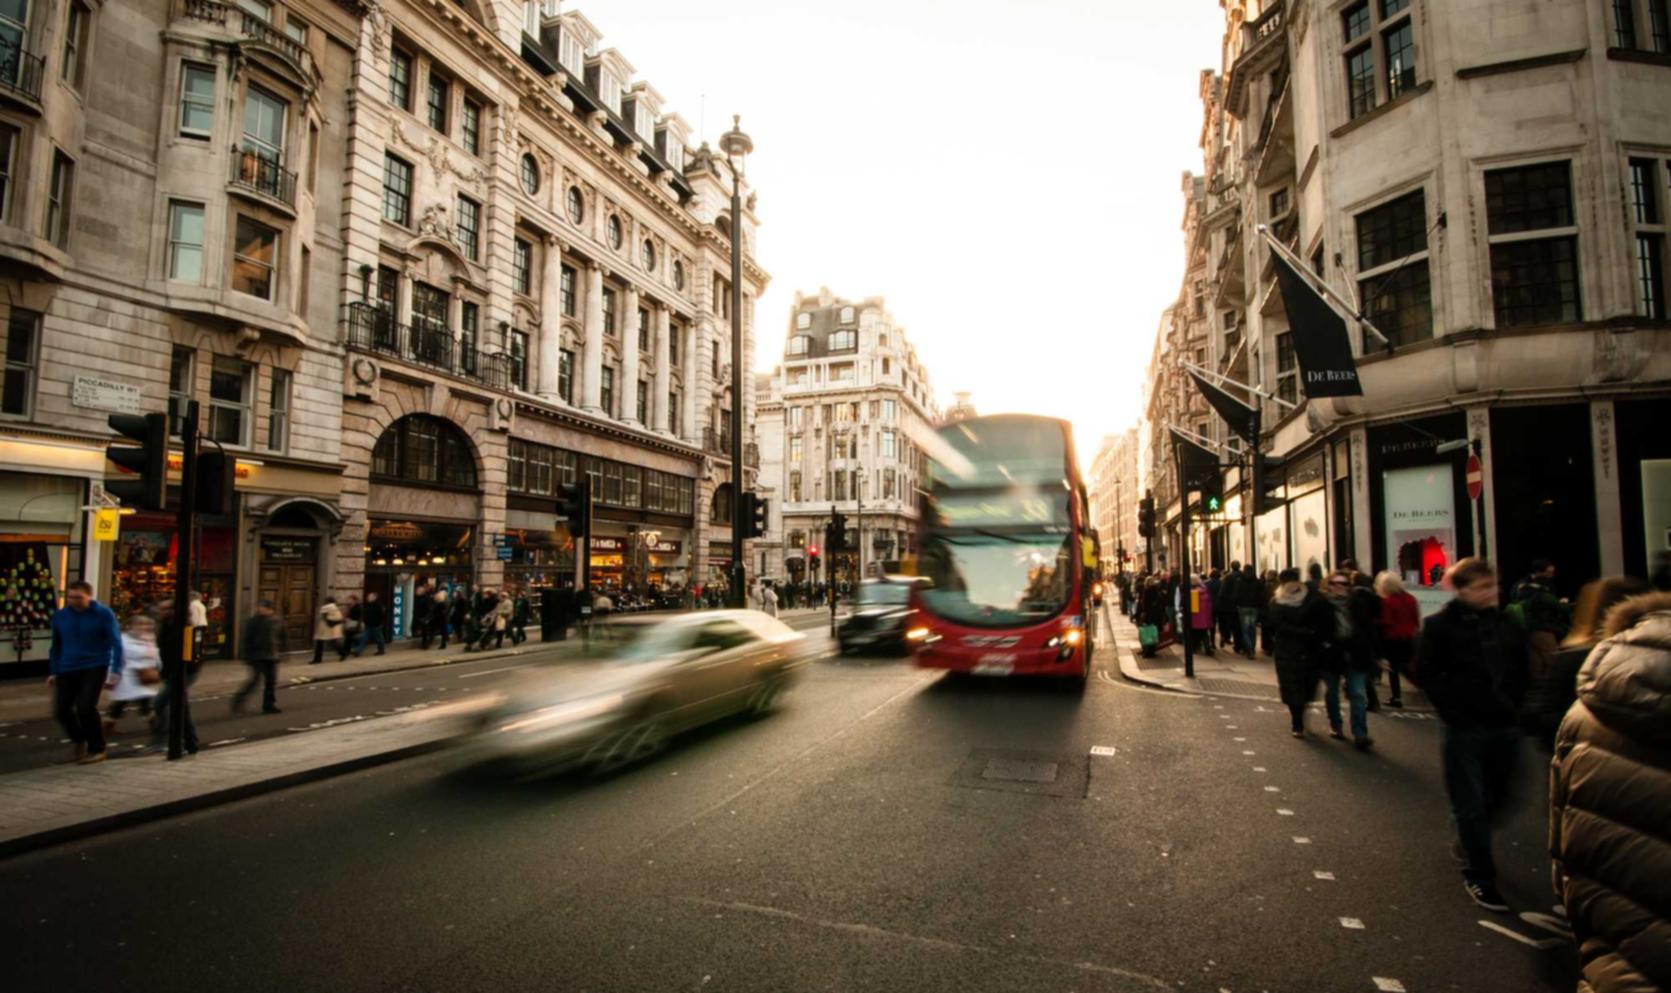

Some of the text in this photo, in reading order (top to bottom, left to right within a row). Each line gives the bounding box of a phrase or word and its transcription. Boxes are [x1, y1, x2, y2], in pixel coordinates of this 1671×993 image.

[1308, 370, 1325, 383] DE
[78, 377, 124, 391] PICCADILLY
[393, 585, 402, 635] MONEY
